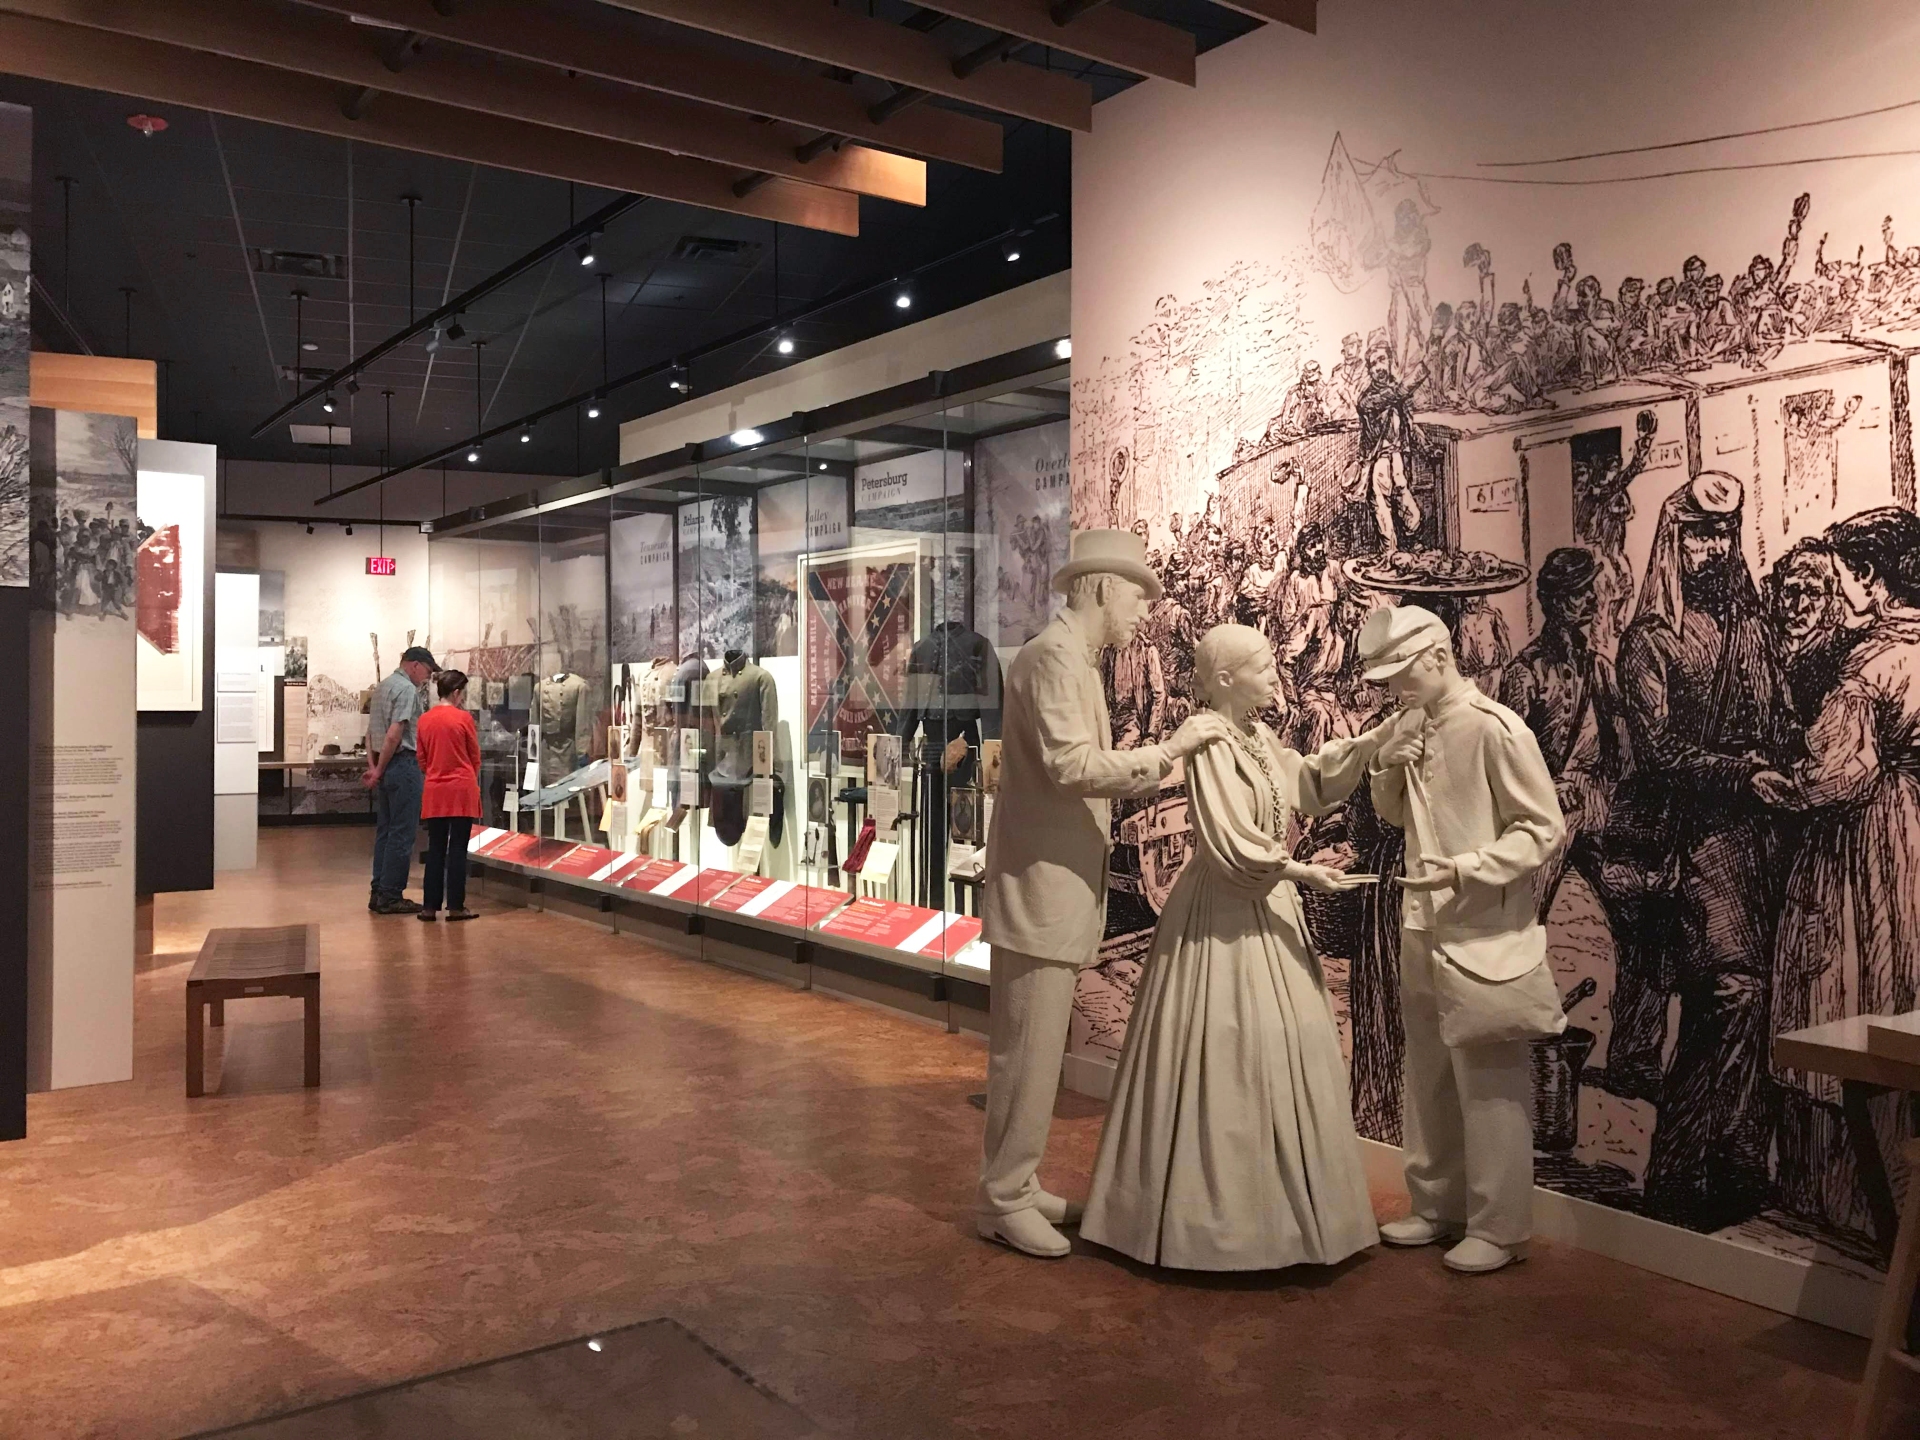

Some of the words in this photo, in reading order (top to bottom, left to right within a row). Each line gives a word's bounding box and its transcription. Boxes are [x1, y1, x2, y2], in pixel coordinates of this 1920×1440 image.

[861, 471, 908, 491] Petersburg
[682, 513, 705, 527] Atlana
[806, 509, 829, 524] alley
[807, 521, 842, 538] AMPAIGN
[370, 558, 392, 574] EXIT
